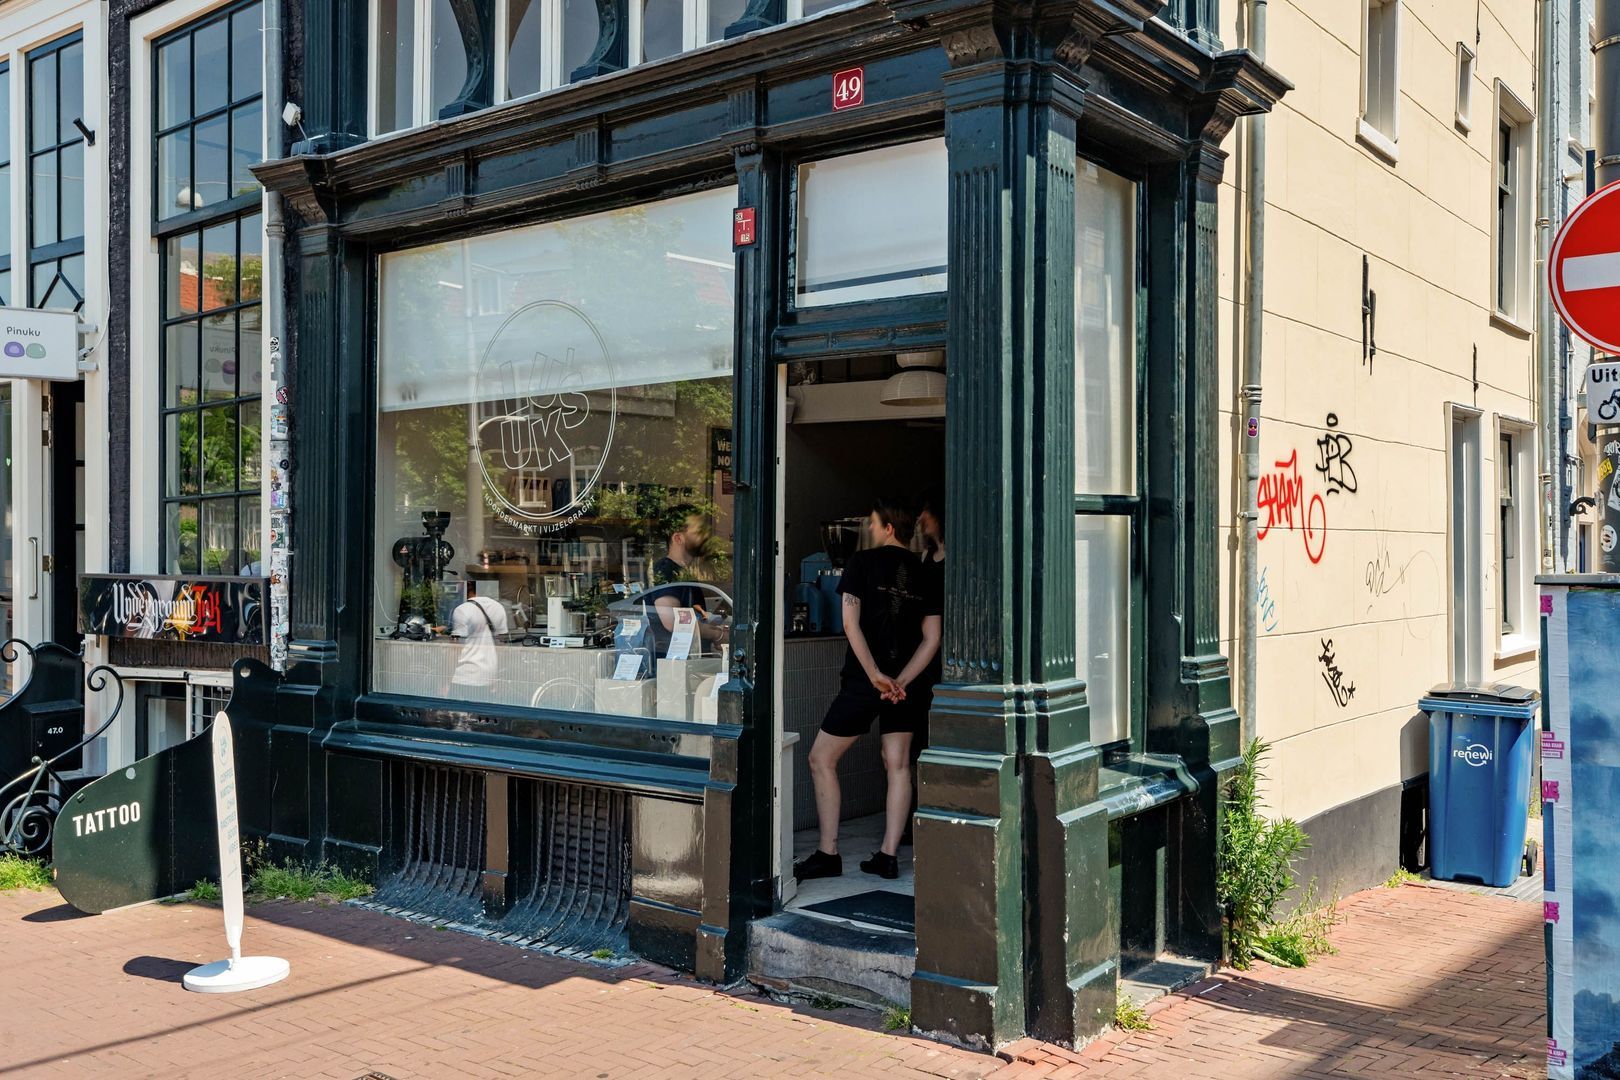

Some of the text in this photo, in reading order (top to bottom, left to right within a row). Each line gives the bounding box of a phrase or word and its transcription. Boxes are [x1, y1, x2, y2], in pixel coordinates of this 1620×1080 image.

[836, 76, 861, 102] 49
[6, 326, 41, 336] Pinuku
[717, 455, 732, 467] NO
[484, 493, 596, 534] NOORDERMARKT VIJZELGRACHT
[112, 582, 198, 634] Underground
[1453, 749, 1493, 761] renewi
[72, 801, 141, 837] TATTOO
